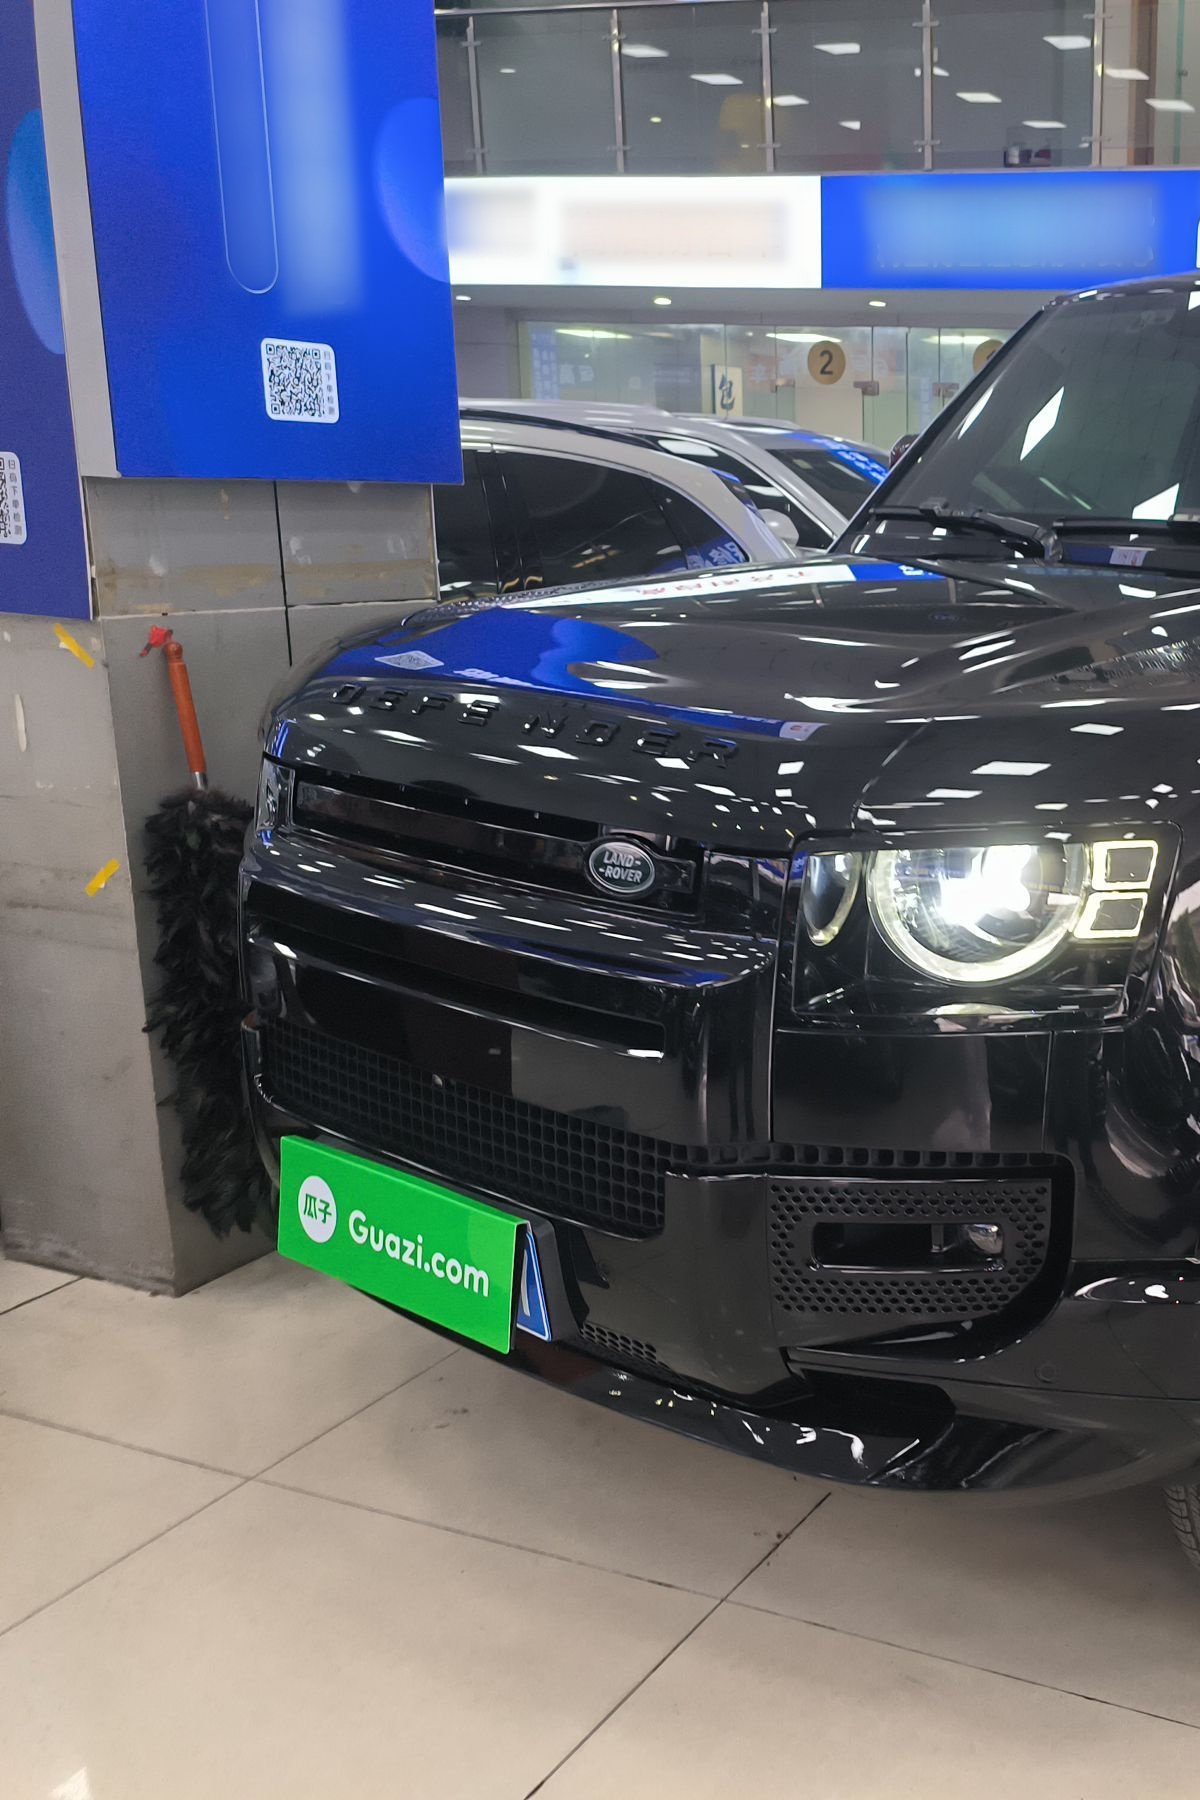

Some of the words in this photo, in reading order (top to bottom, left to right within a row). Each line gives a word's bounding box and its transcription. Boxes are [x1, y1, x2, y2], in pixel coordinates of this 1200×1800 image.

[819, 349, 833, 376] 2
[331, 682, 739, 768] DEFENDER
[303, 1192, 332, 1224] 瓜子
[348, 1208, 490, 1298] Guazi.com
